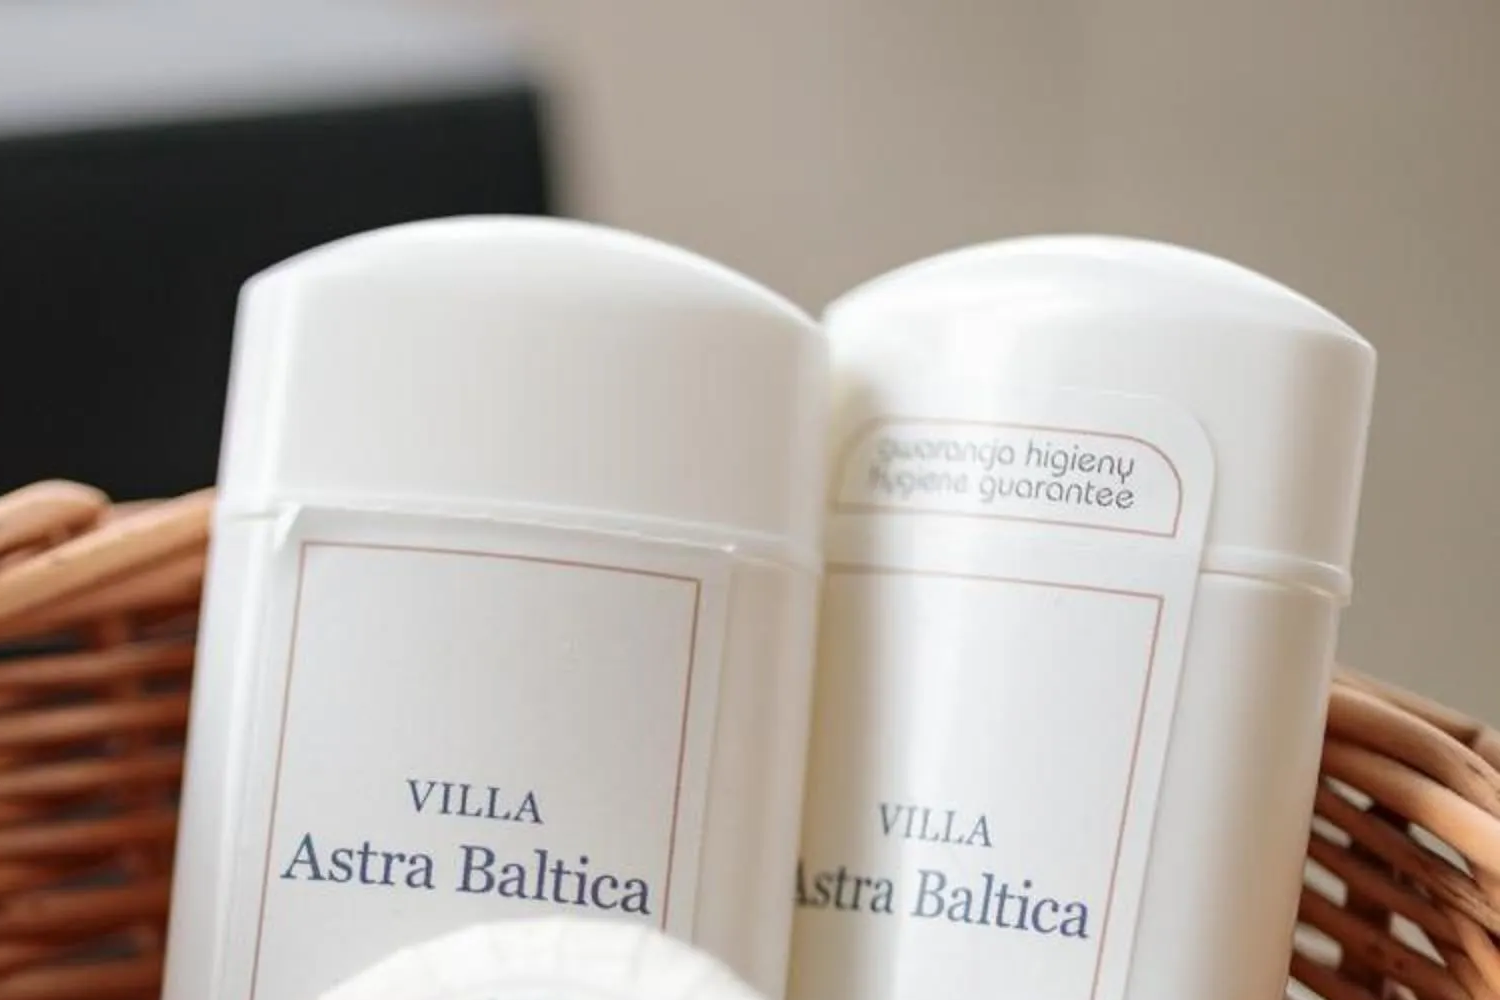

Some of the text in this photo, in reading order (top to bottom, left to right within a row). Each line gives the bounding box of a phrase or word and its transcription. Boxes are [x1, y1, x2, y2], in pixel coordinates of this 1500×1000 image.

[1025, 438, 1135, 484] higieny
[979, 472, 1135, 509] guarantee
[406, 778, 545, 825] VILLA
[879, 802, 994, 849] VILLA
[280, 831, 652, 915] Astra Baltica
[910, 868, 1090, 939] Baltica
